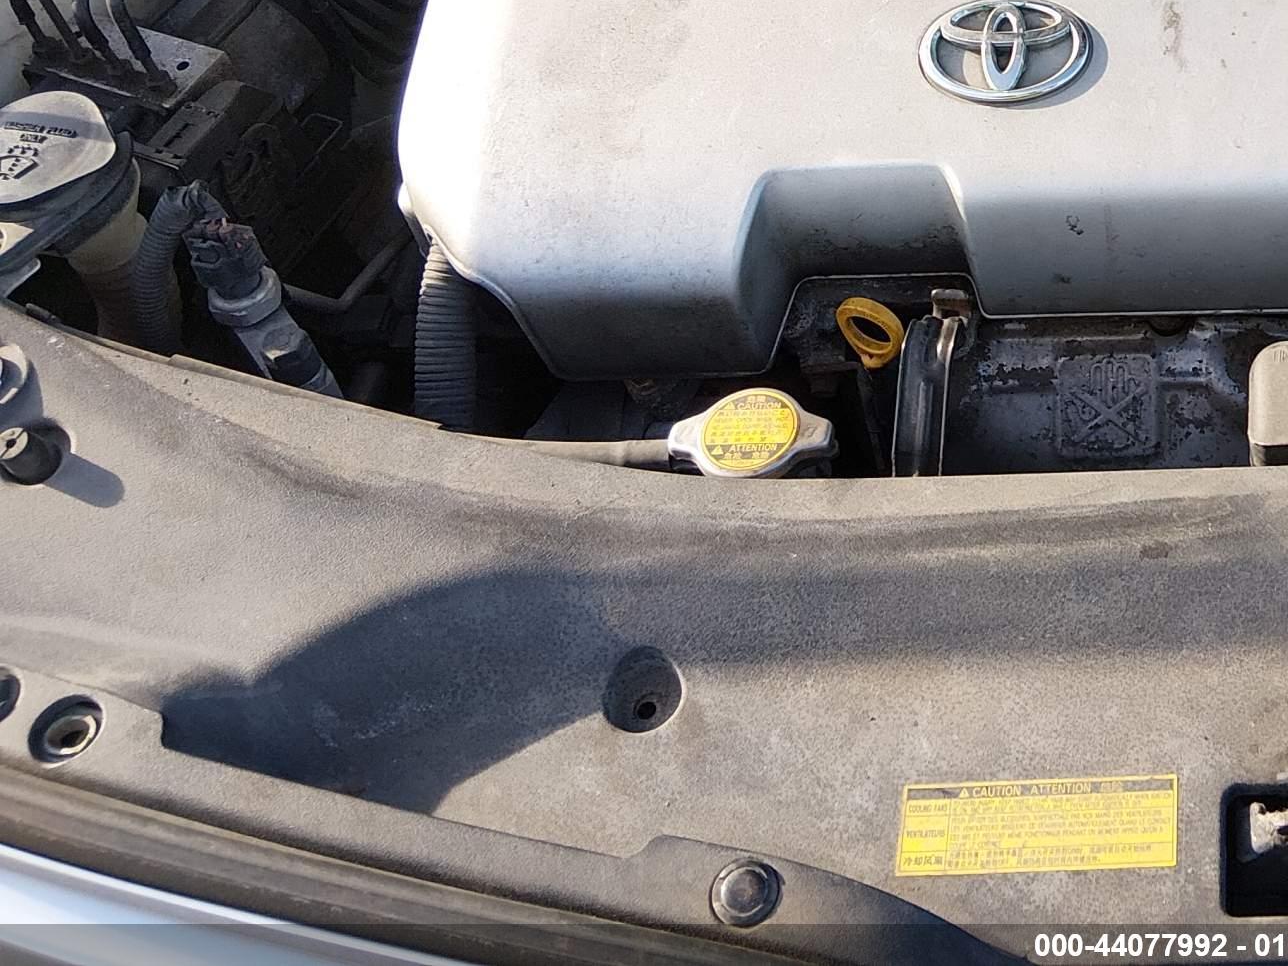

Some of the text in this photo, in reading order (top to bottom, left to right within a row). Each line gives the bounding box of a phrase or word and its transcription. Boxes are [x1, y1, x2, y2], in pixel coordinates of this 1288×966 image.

[737, 401, 782, 410] CAUTION
[729, 443, 778, 453] ATTENTION
[972, 785, 1022, 798] CAUTION
[1030, 782, 1092, 796] ATTENTION
